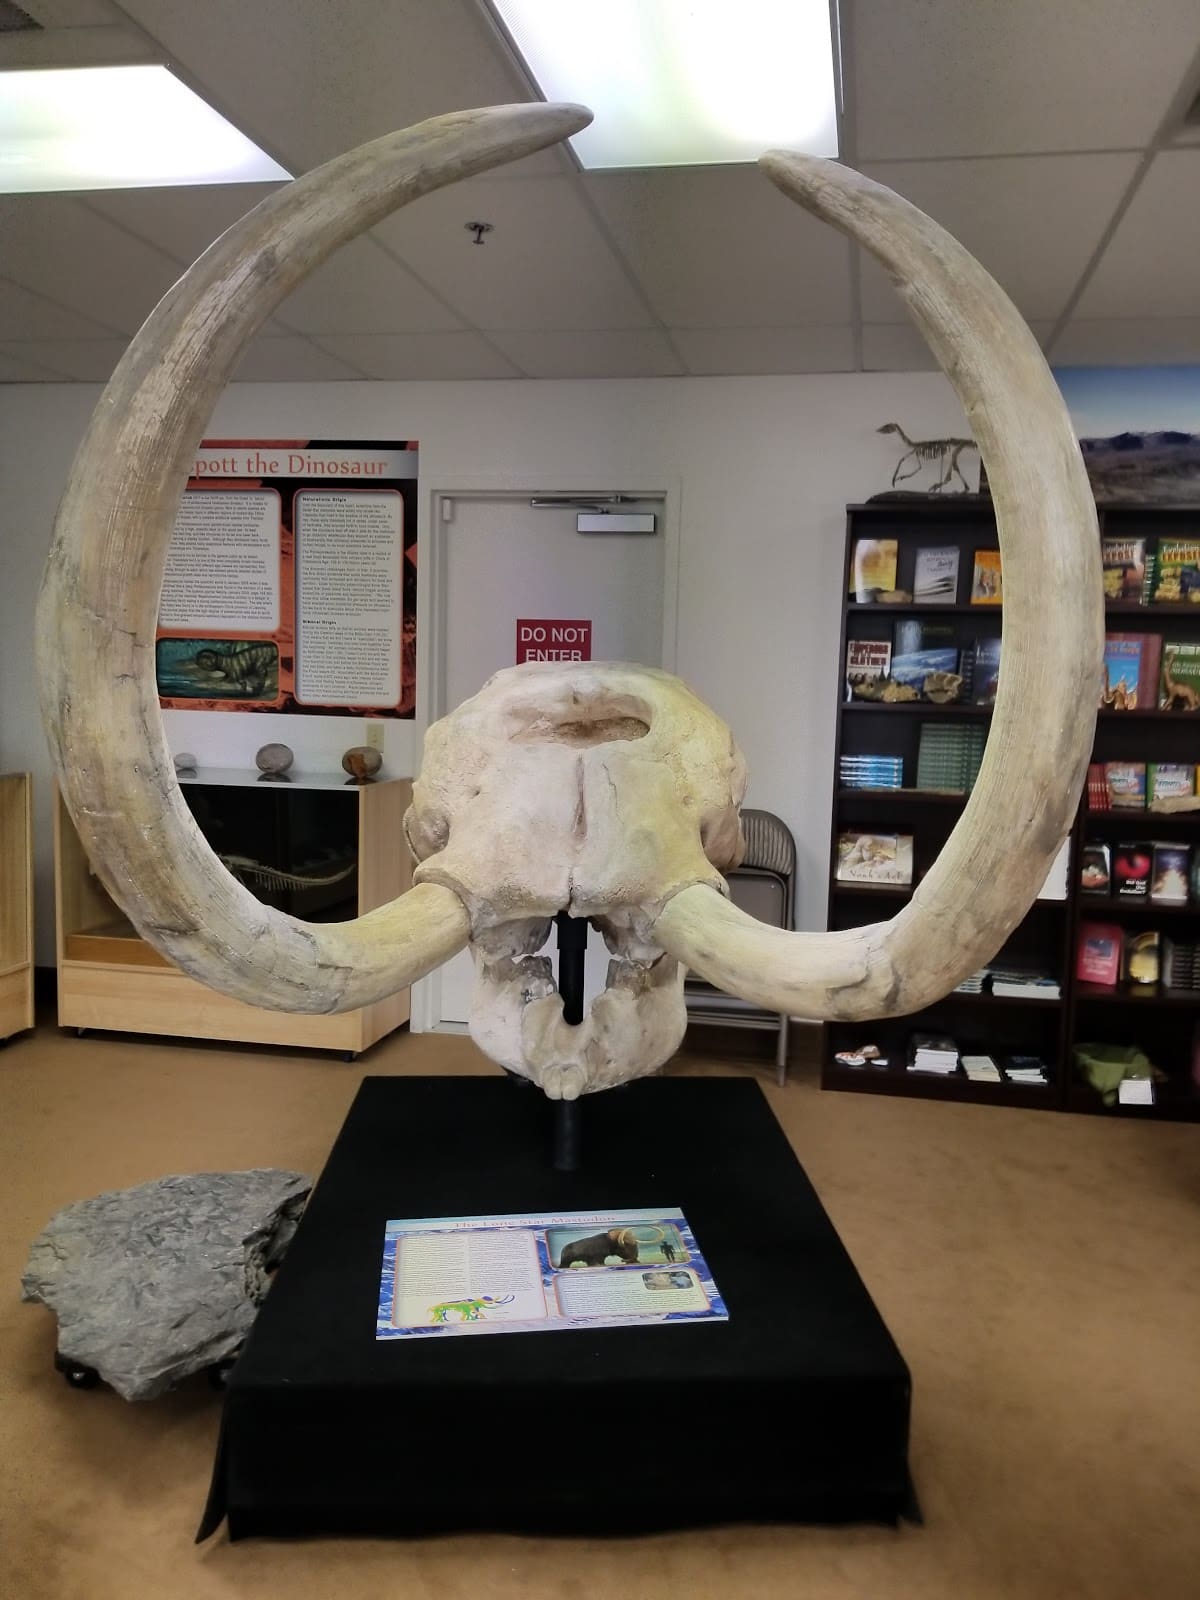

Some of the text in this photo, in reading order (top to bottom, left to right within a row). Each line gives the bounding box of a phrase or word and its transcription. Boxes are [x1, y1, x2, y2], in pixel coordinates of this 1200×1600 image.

[191, 452, 388, 480] pott the Dinosaur
[521, 626, 589, 643] DO NOT
[525, 648, 582, 663] ENTER
